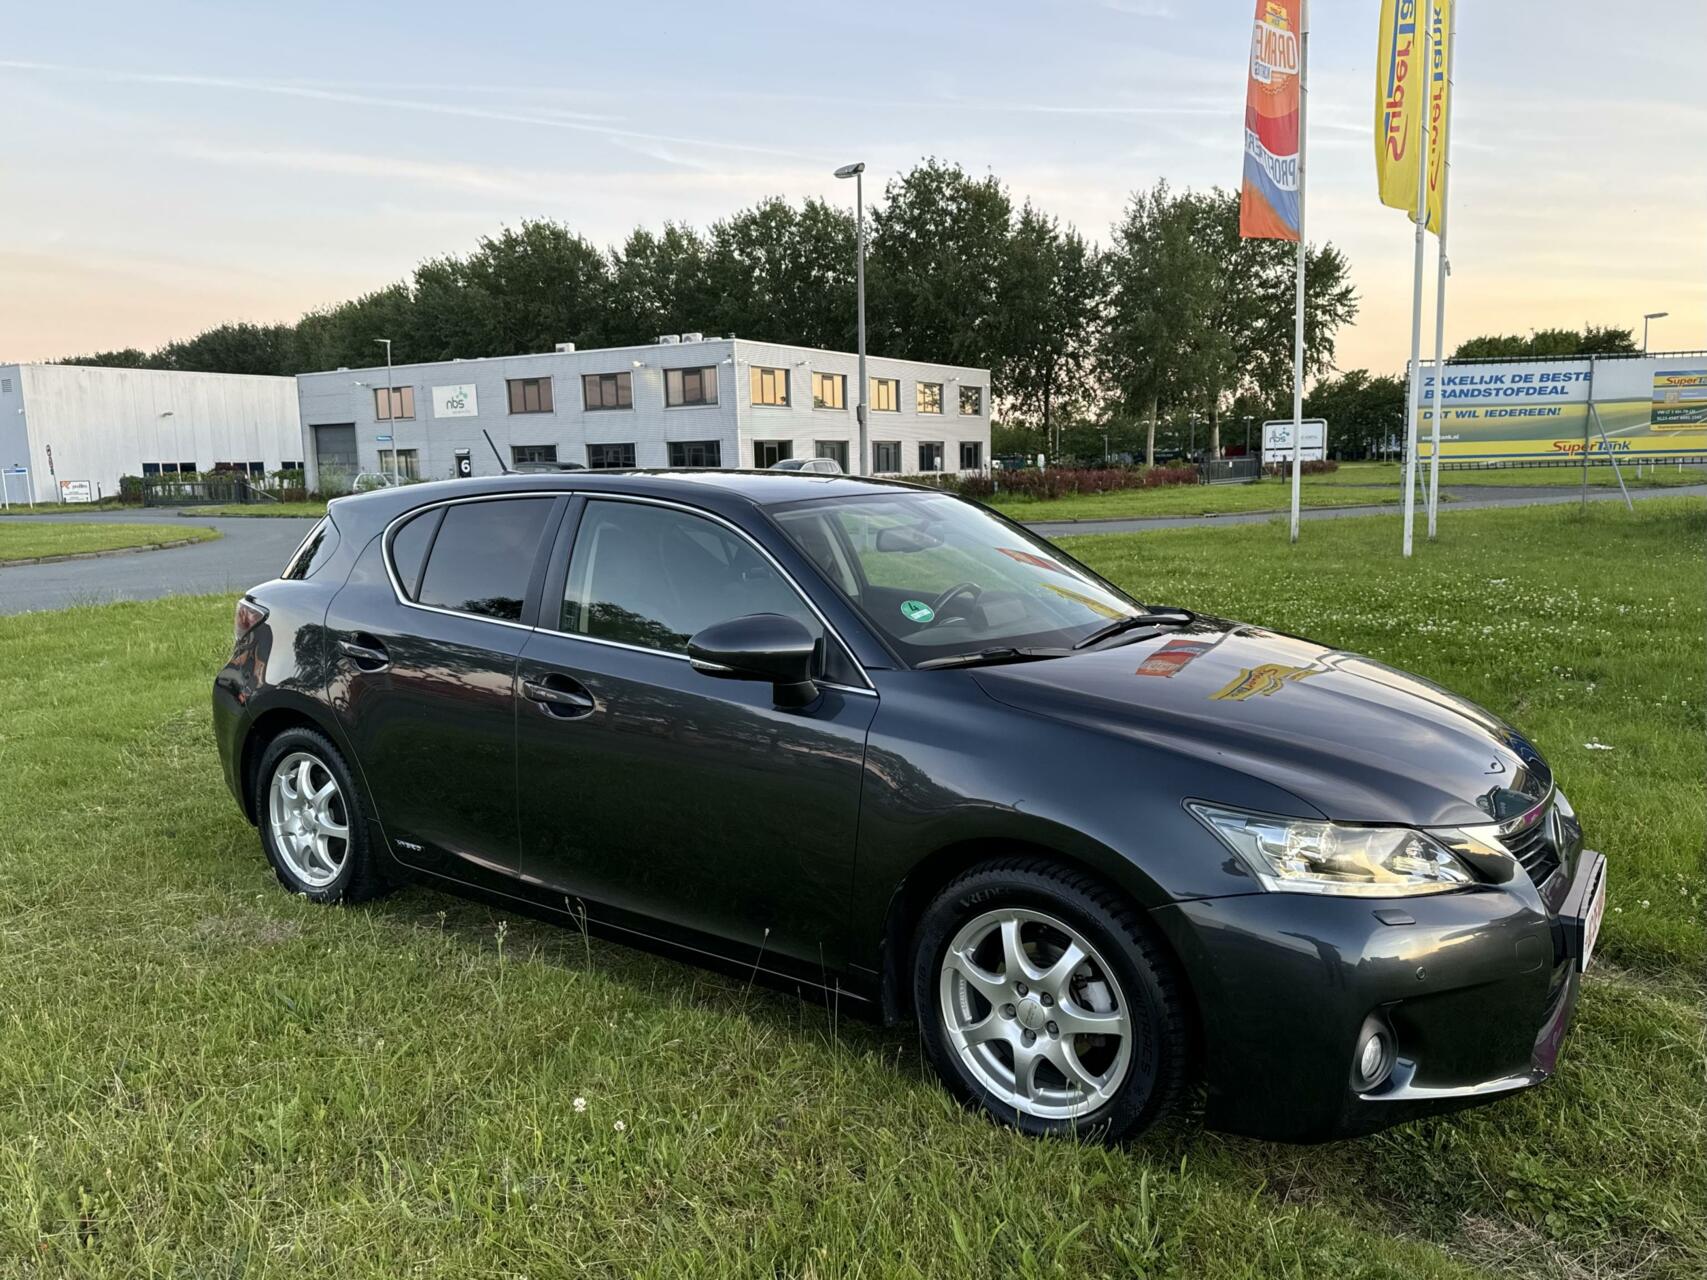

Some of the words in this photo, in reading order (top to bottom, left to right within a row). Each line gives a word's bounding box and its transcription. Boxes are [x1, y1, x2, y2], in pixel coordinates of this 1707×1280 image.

[1510, 373, 1535, 384] DE
[1539, 371, 1593, 383] BESTE
[446, 396, 465, 410] nbs
[1423, 410, 1451, 420] DT
[1455, 409, 1480, 419] WIL
[1484, 407, 1562, 418] IEDEREEN!
[460, 459, 471, 473] 6
